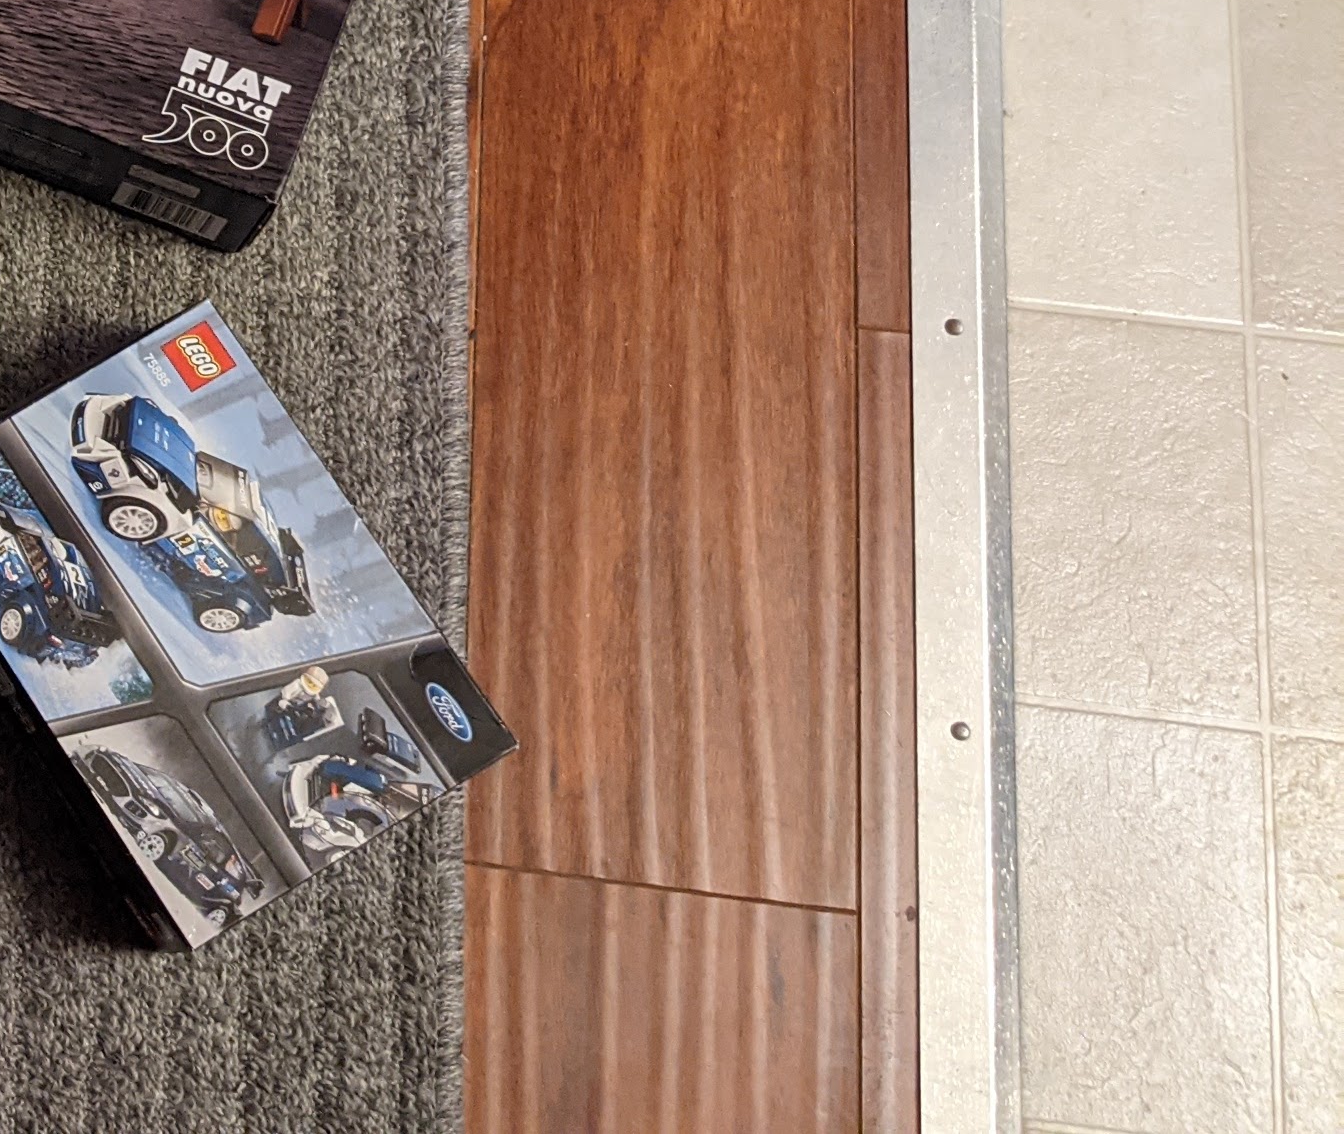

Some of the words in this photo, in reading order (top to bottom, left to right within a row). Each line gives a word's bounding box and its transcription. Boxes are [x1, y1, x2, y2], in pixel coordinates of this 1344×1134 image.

[177, 75, 273, 121] nuova
[180, 47, 292, 107] FIAT
[142, 86, 269, 171] 500
[143, 353, 171, 387] 75885
[178, 337, 220, 377] LEGO
[432, 695, 466, 732] Ford
